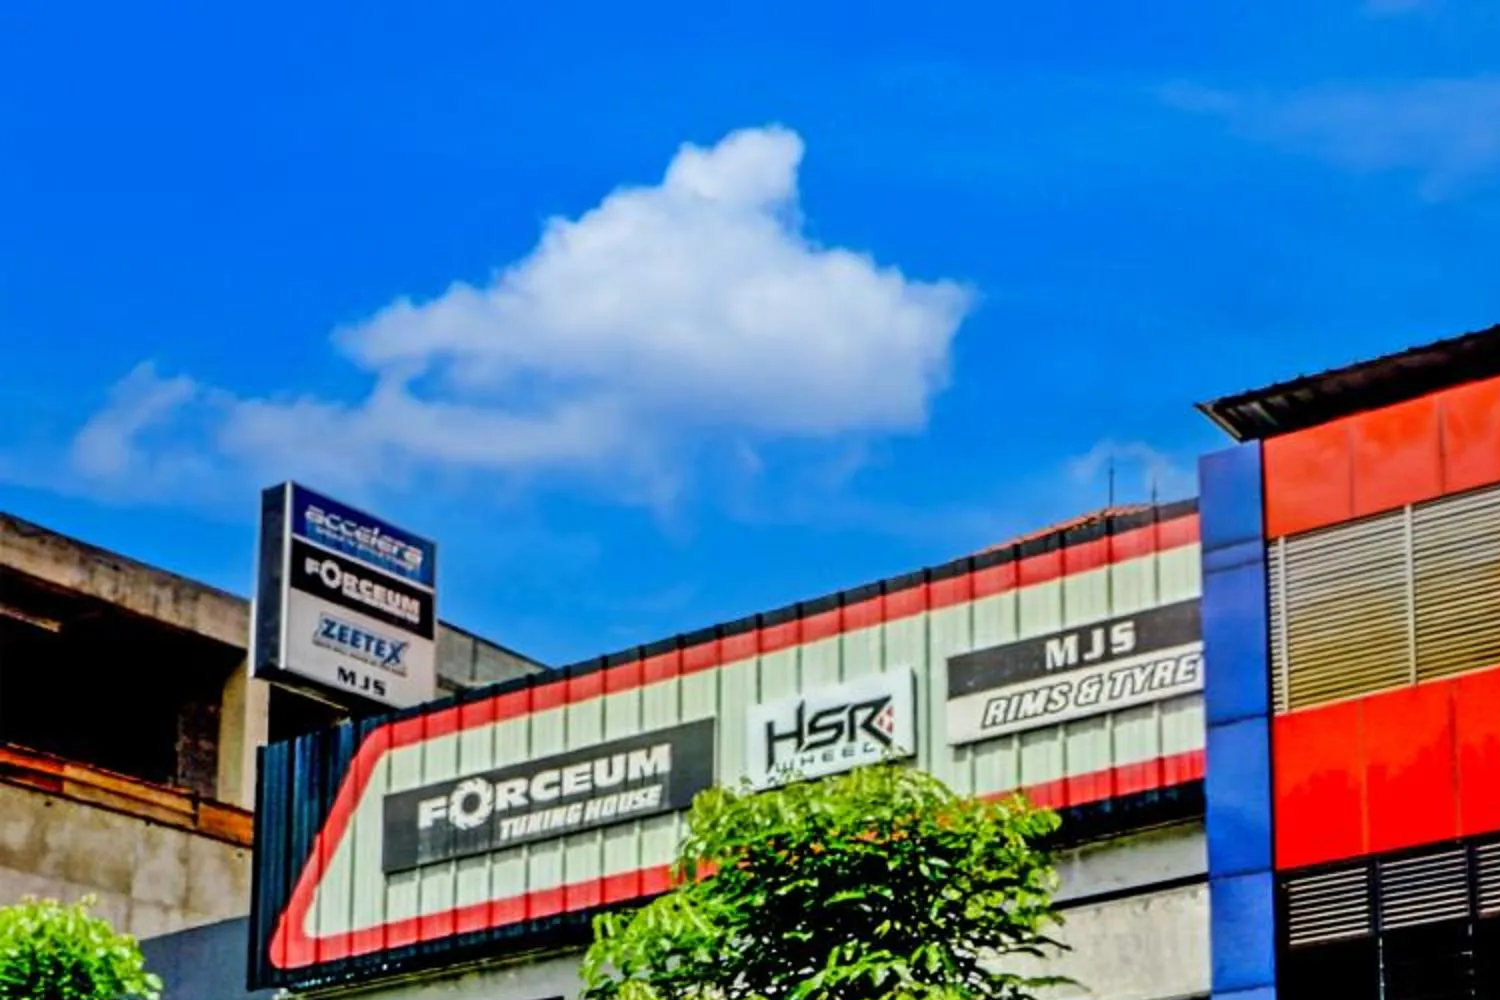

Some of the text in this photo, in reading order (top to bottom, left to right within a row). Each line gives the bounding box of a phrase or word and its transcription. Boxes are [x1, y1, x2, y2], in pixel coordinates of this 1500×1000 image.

[304, 557, 421, 615] FORCEUM
[321, 618, 409, 666] ZEETEX
[1044, 620, 1137, 670] MJS
[337, 667, 387, 697] MJS
[981, 680, 1073, 730] RIMS
[1074, 673, 1105, 707] &
[766, 695, 894, 774] HSR
[418, 744, 673, 830] FORCEUM
[499, 783, 664, 842] TUNING HOUSE
